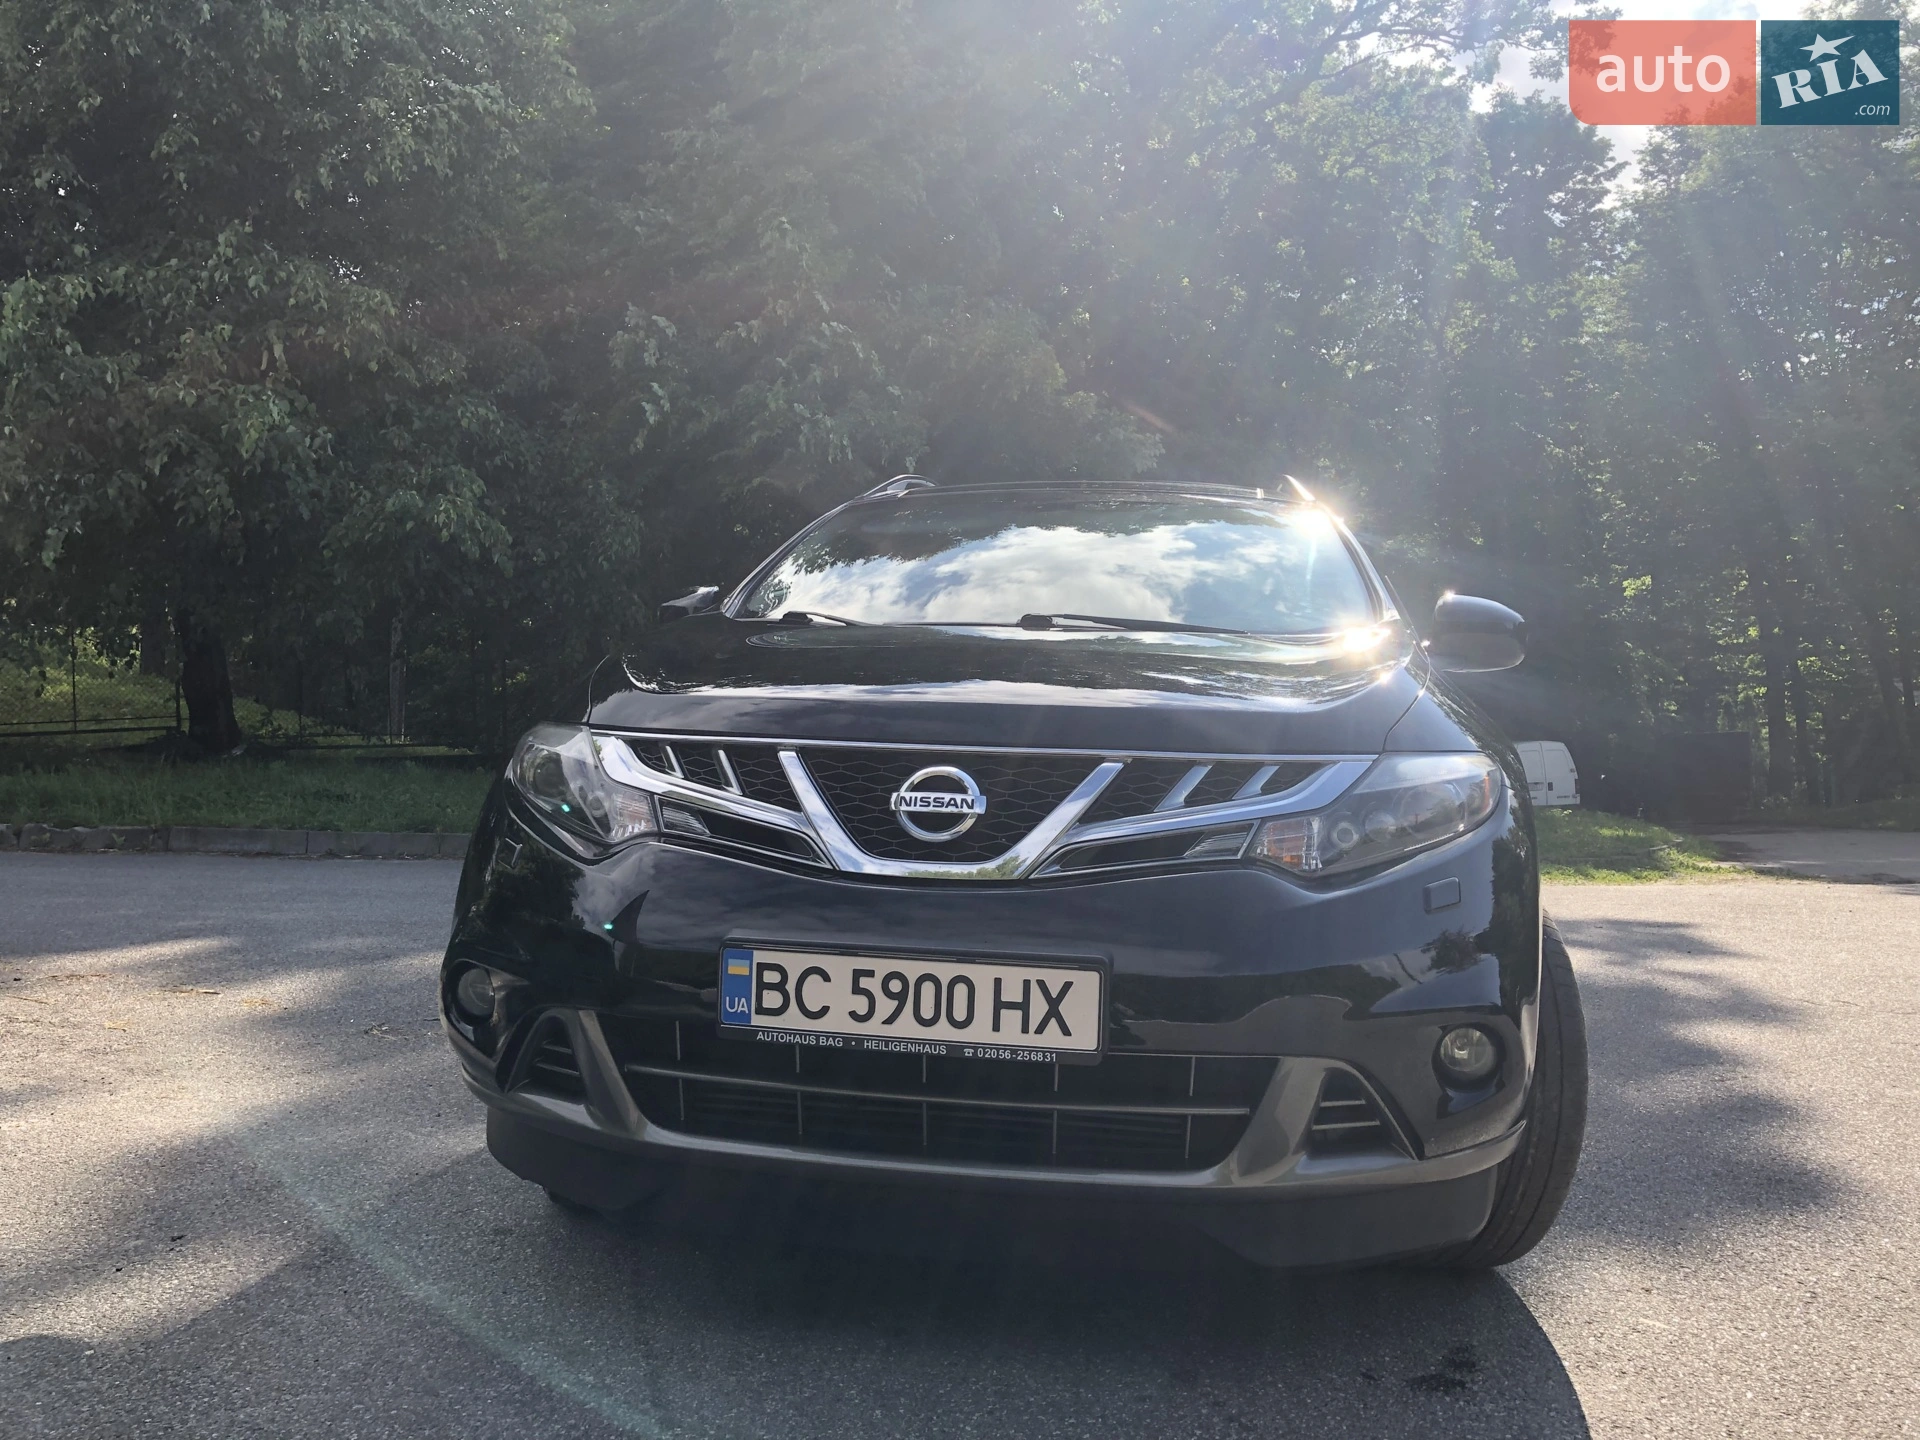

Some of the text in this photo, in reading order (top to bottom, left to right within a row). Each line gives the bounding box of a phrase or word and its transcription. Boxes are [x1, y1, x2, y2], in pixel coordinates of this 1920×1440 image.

[899, 796, 975, 810] NISSAN
[725, 996, 749, 1014] UA
[755, 962, 1074, 1037] BC 5900 HX
[756, 1032, 1057, 1062] AUTOHAUS BAG HEILIGENHAUS 02056-256831
